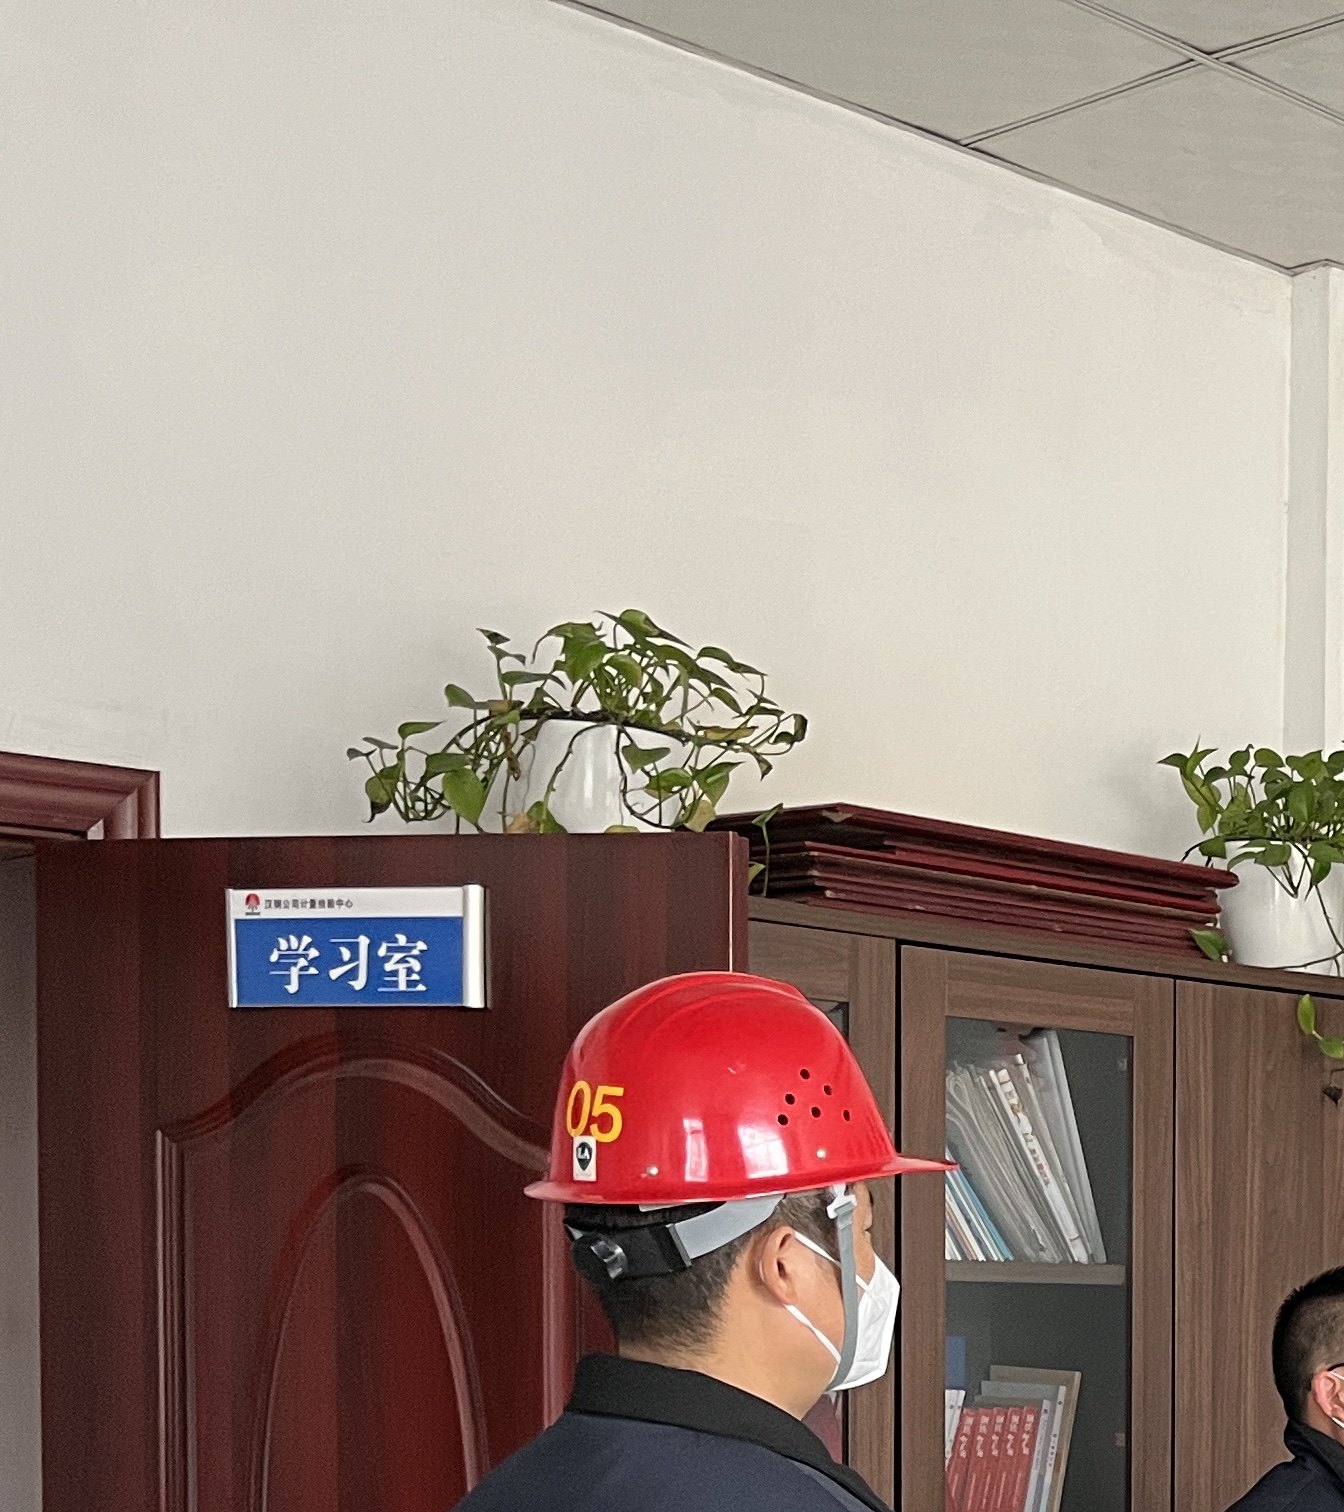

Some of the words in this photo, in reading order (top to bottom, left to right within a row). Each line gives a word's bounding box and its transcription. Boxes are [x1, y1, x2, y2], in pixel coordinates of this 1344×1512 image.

[268, 932, 429, 995] 学习室
[566, 1080, 625, 1144] 05
